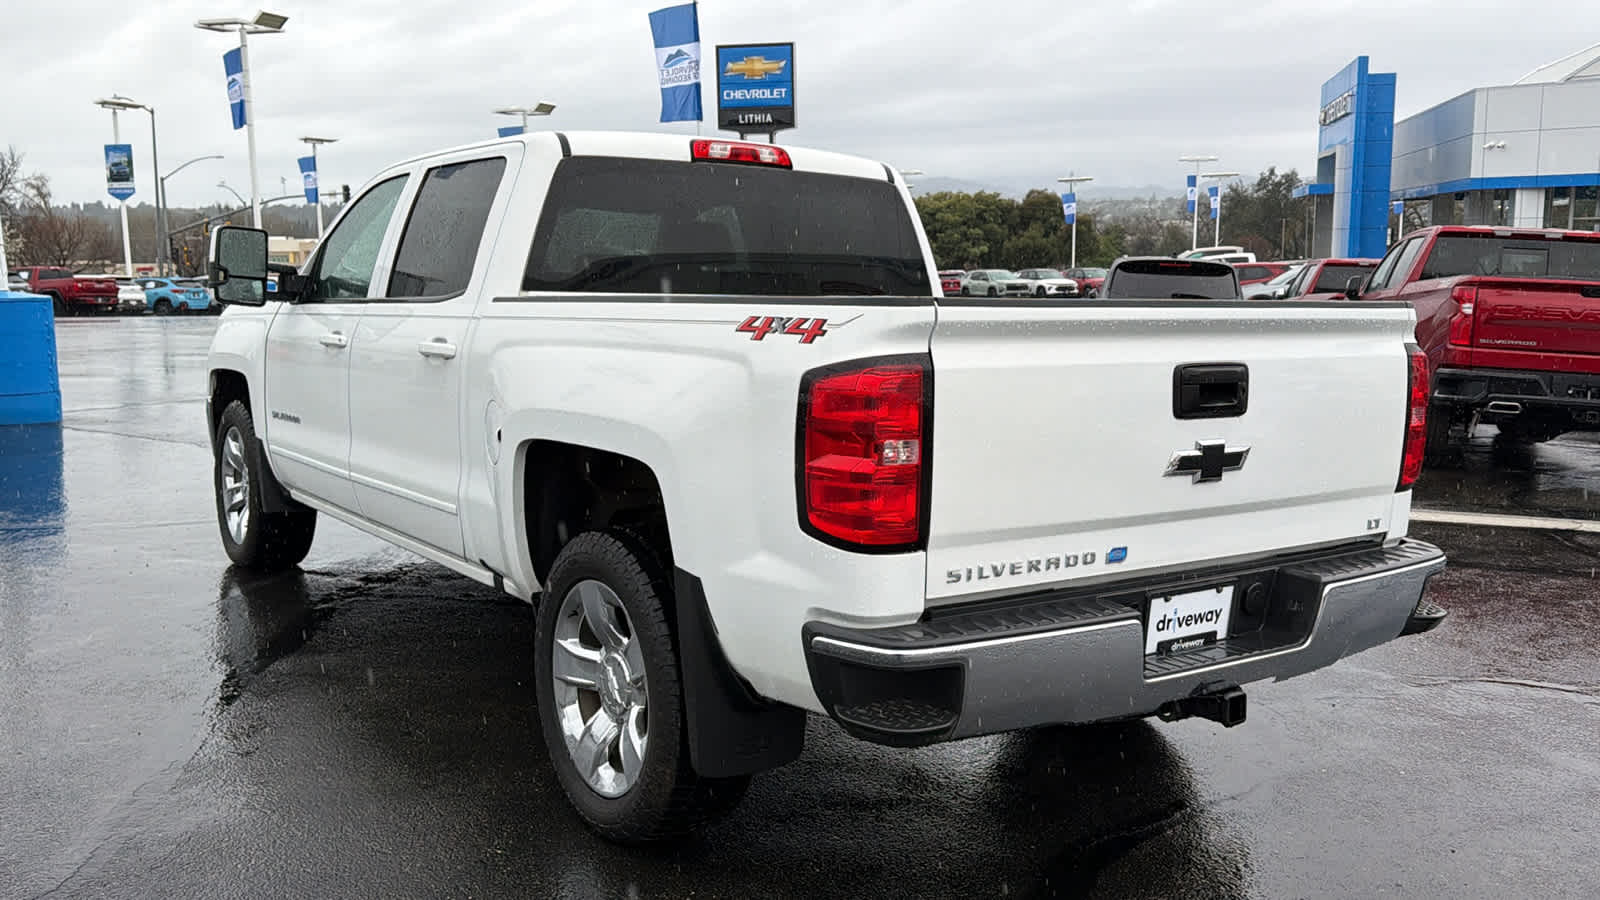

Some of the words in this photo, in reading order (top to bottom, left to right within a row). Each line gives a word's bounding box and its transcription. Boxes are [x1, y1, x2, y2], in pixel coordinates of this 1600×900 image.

[723, 88, 787, 100] CHEVROLET
[738, 113, 773, 124] LITHIA
[1367, 518, 1381, 530] LT
[946, 551, 1097, 584] SILVERADO
[1156, 608, 1223, 632] driveway
[1171, 638, 1205, 651] driveway
